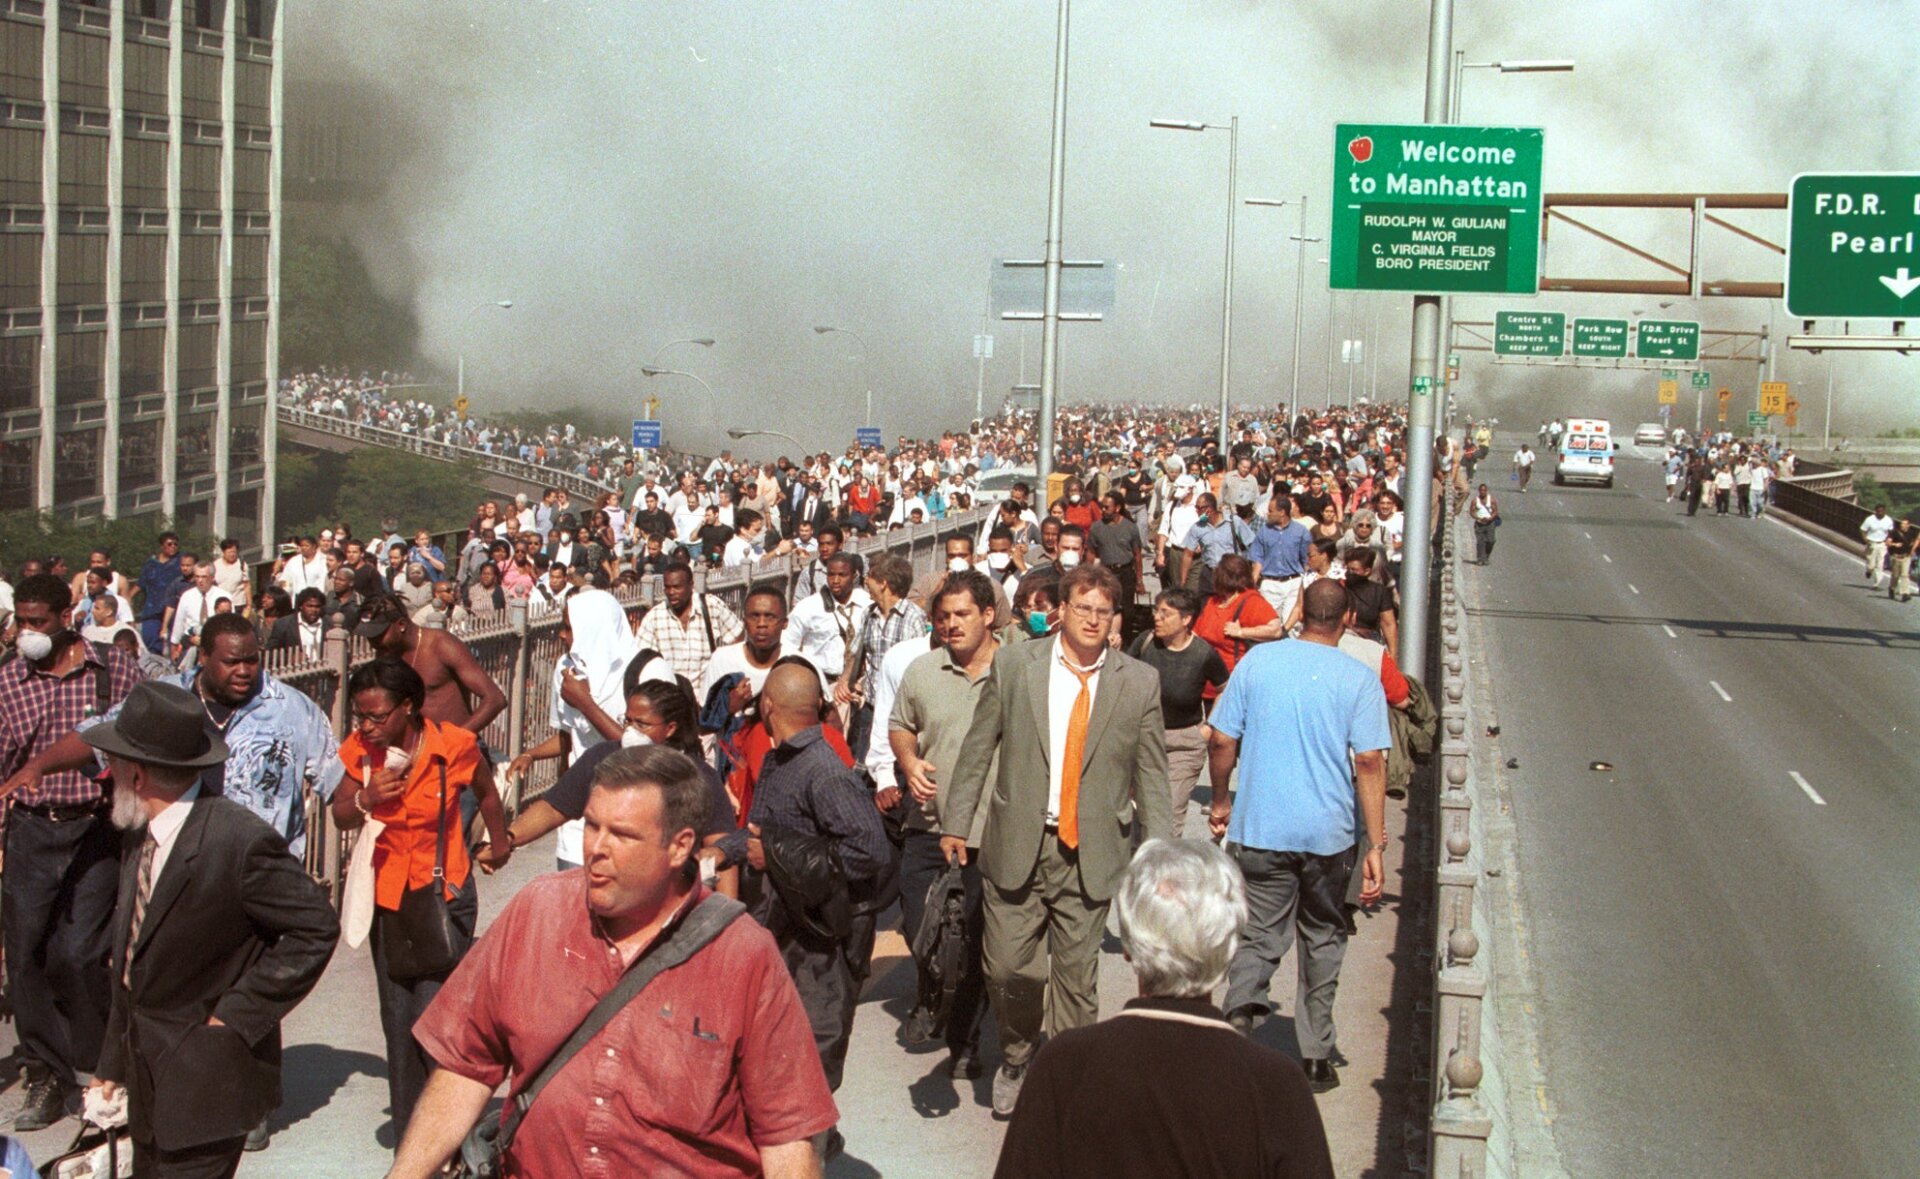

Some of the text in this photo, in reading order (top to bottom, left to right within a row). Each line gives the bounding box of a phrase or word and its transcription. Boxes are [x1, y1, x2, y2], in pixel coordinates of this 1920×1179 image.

[1401, 139, 1516, 164] Welcome
[1349, 172, 1527, 198] to Manhattan
[1815, 193, 1886, 215] F.D.R.
[1364, 215, 1506, 230] RUDOLPH W. GIULIANI
[1412, 230, 1457, 242] MAYOR
[1830, 231, 1914, 253] Pearl
[1372, 243, 1496, 257] C. VIRGINIA FIELDS
[1376, 257, 1490, 271] BORO PRESIDENT
[1507, 315, 1536, 323] Centre
[1578, 324, 1623, 334] Park Row
[1669, 325, 1695, 334] Drive
[1499, 334, 1543, 342] Chambers
[1646, 336, 1671, 344] Pearl
[1766, 395, 1780, 406] 15
